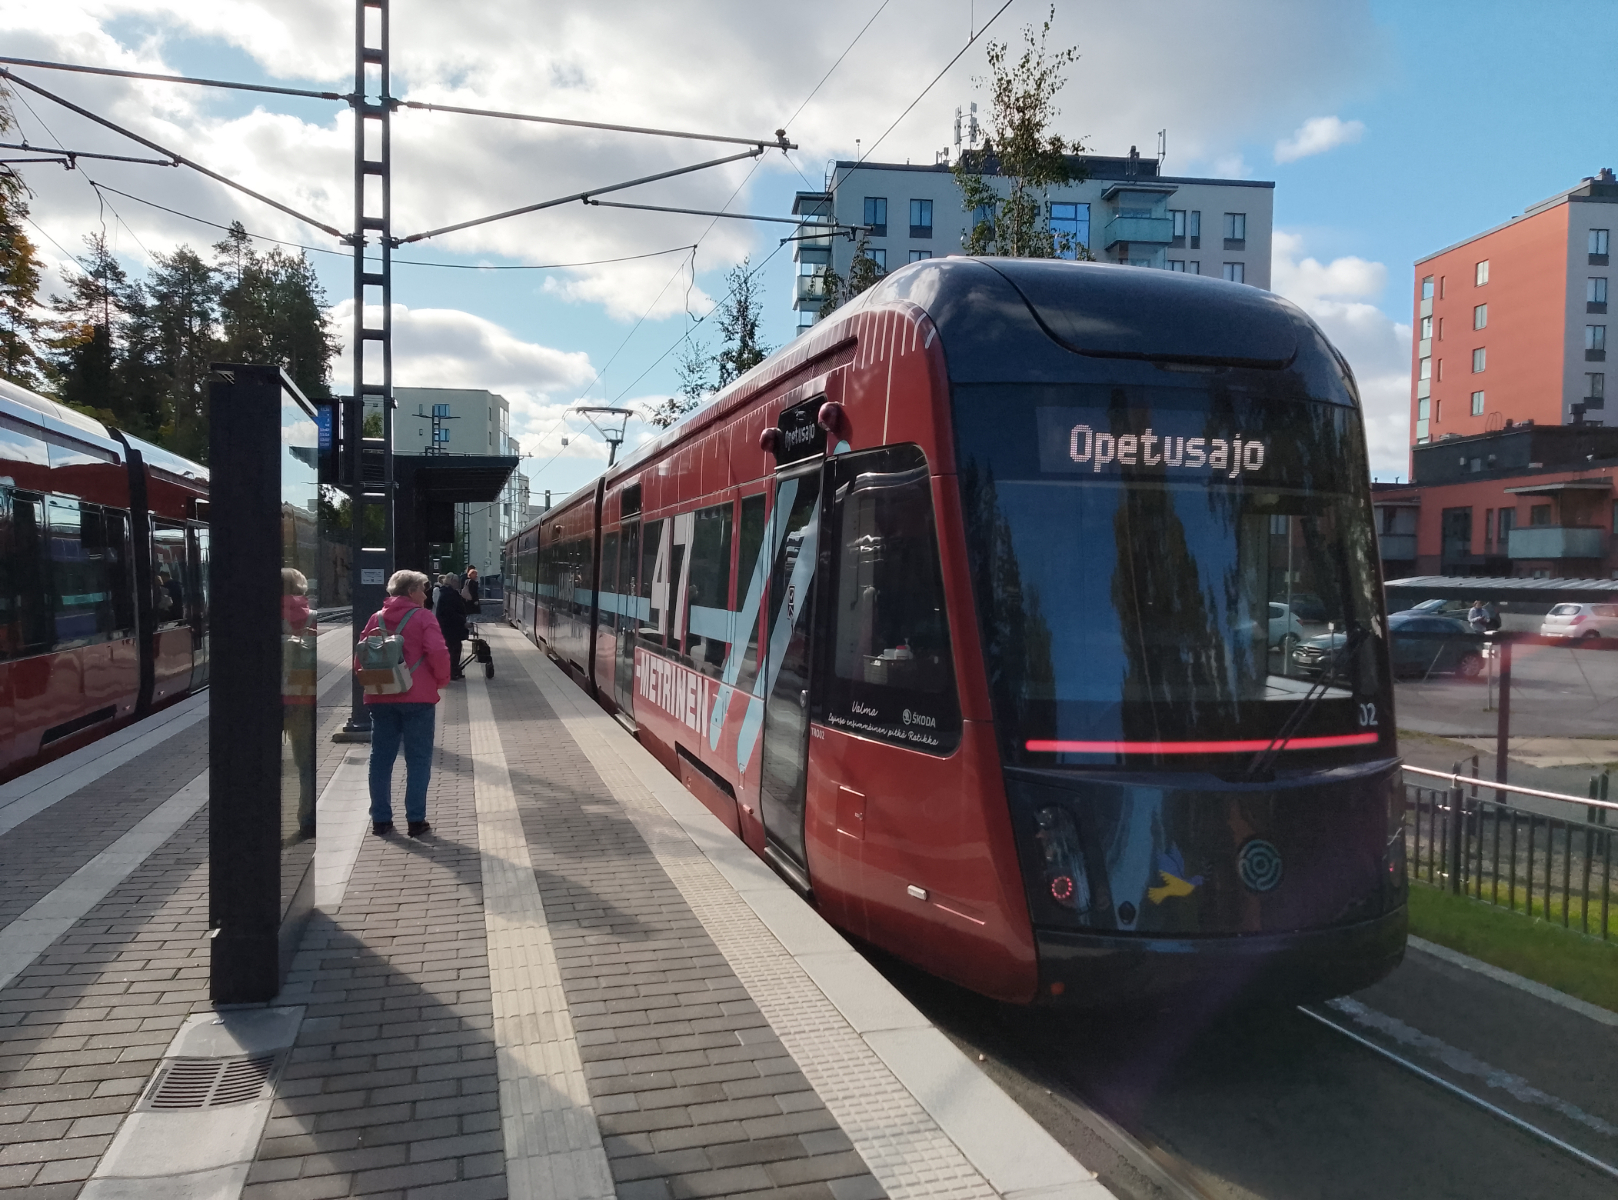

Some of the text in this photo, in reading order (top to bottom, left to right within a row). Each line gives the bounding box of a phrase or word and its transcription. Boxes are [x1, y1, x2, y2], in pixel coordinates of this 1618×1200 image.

[1069, 424, 1265, 479] Opetusajo
[651, 511, 695, 640] 47
[912, 711, 936, 728] ŠKODA
[1360, 703, 1378, 726] 02
[887, 728, 907, 739] pitkä
